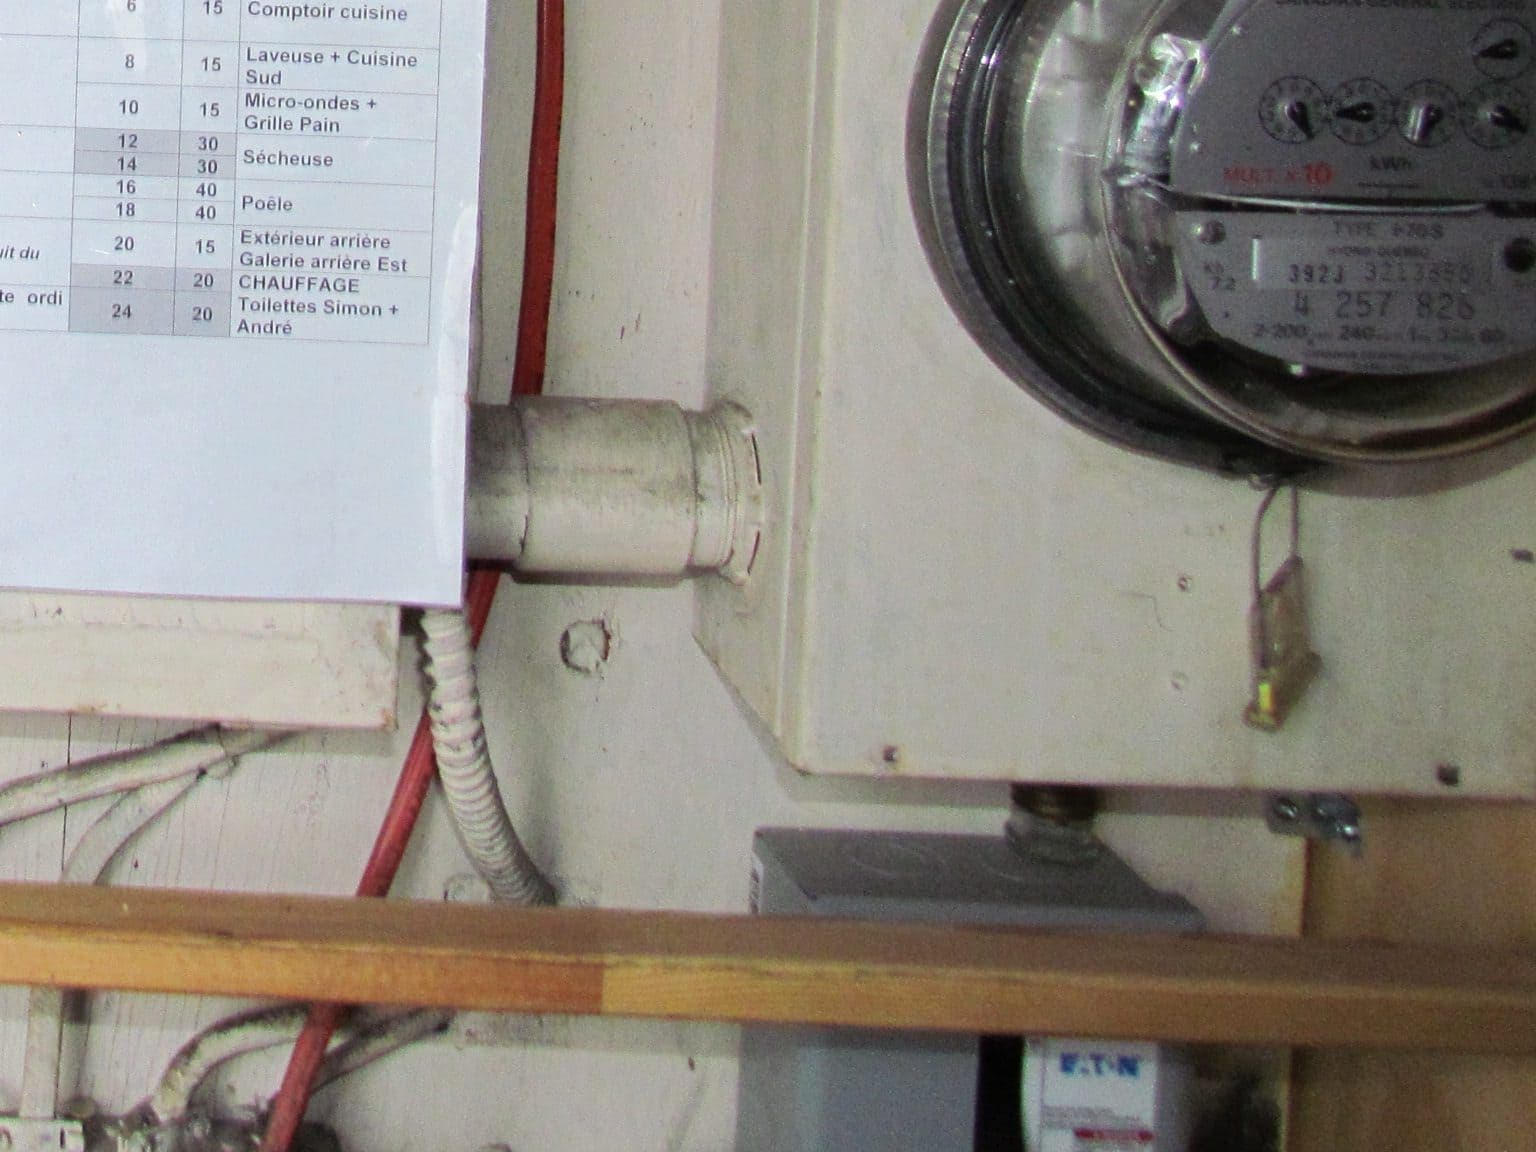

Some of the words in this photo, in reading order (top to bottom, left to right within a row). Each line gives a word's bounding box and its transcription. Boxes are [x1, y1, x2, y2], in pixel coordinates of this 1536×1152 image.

[203, 0, 224, 15] 15
[247, 0, 335, 22] Comptoir
[340, 5, 408, 22] cuisine
[124, 54, 135, 69] 8
[201, 56, 222, 72] 15
[246, 48, 325, 65] Laveuse
[330, 53, 341, 65] +
[346, 51, 418, 69] Cuisine
[245, 68, 283, 87] Sud
[119, 99, 140, 115] 10
[200, 102, 221, 118] 15
[244, 92, 360, 111] Micro-ondes
[366, 99, 377, 110] +
[244, 114, 294, 131] Grille
[300, 116, 341, 133] Pain
[117, 133, 138, 148] 12
[198, 136, 219, 151] 30
[243, 149, 334, 167] Sécheuse
[117, 156, 138, 172] 14
[197, 159, 218, 174] 30
[1302, 161, 1332, 185] 10
[116, 179, 137, 195] 16
[196, 182, 217, 198] 40
[241, 194, 293, 211] Poêle
[115, 201, 136, 217] 18
[195, 205, 216, 220] 40
[114, 235, 135, 251] 20
[194, 239, 215, 254] 15
[240, 229, 325, 247] Extérieur
[330, 233, 391, 249] arrière
[19, 246, 41, 260] du
[239, 251, 305, 268] Galerie
[310, 254, 371, 271] arrière
[377, 256, 408, 273] Est
[113, 269, 134, 285] 22
[193, 273, 214, 288] 20
[238, 274, 360, 294] CHAUFFAGE
[27, 290, 63, 306] ordi
[111, 303, 132, 319] 24
[192, 306, 213, 322] 20
[238, 296, 317, 314] Toilettes
[323, 299, 382, 316] Simon
[388, 304, 399, 315] +
[236, 318, 292, 335] André
